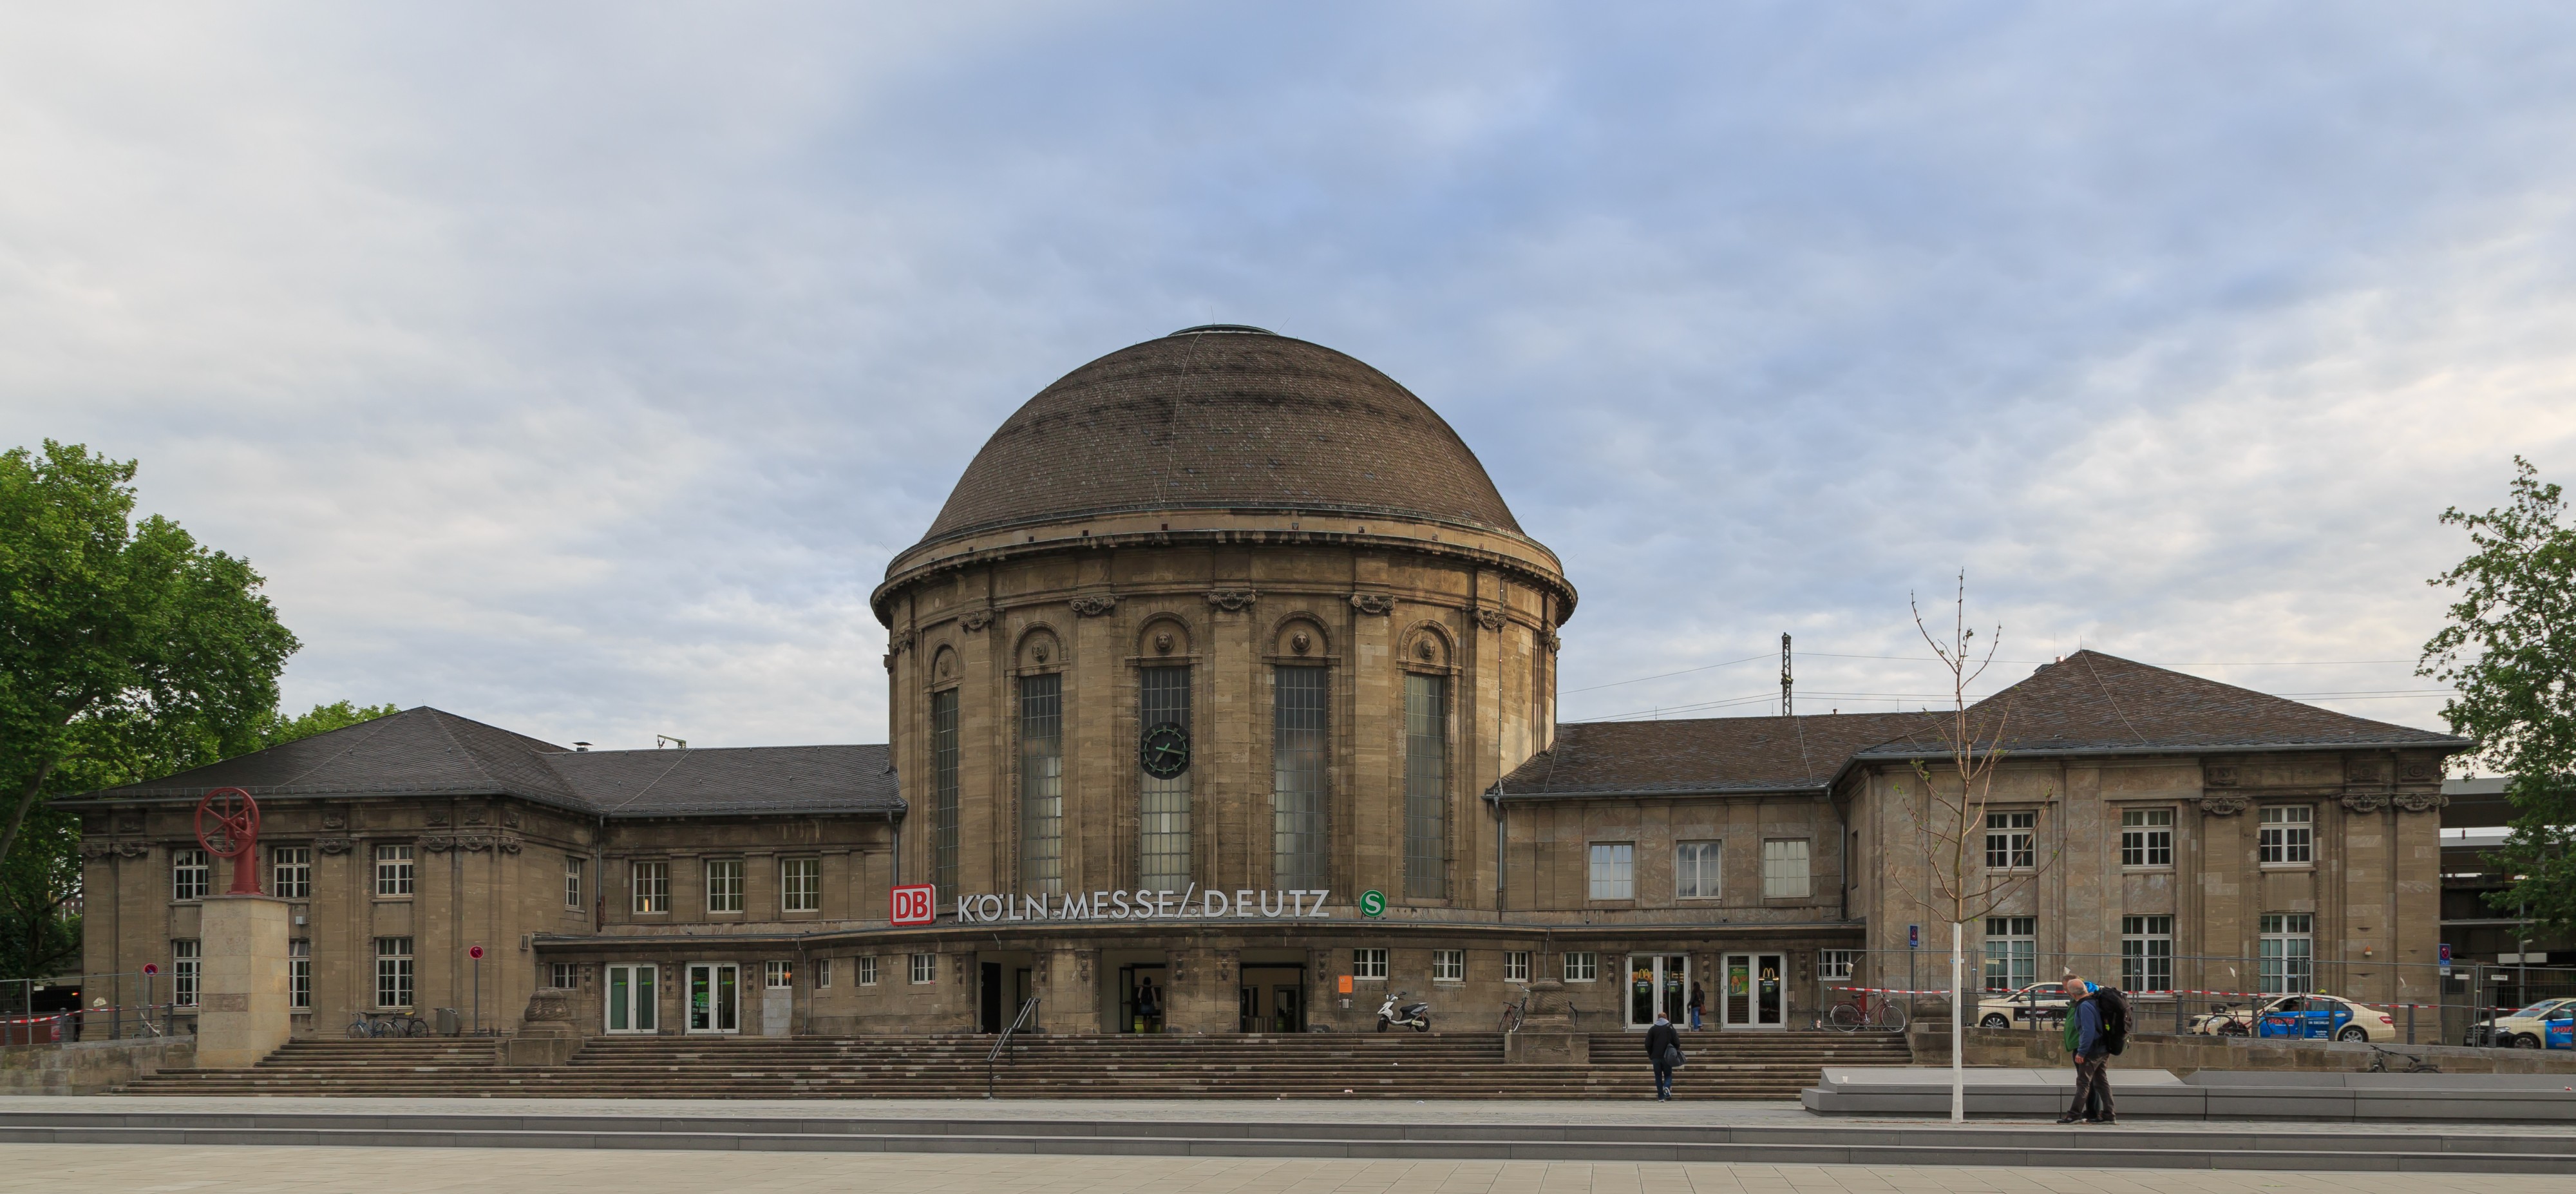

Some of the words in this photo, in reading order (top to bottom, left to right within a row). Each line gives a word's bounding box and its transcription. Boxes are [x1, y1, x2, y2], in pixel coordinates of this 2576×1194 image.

[896, 891, 927, 919] DB
[958, 893, 1048, 922] KÖLN
[1062, 882, 1330, 920] MESSE/DEUTZ
[1365, 893, 1381, 914] S
